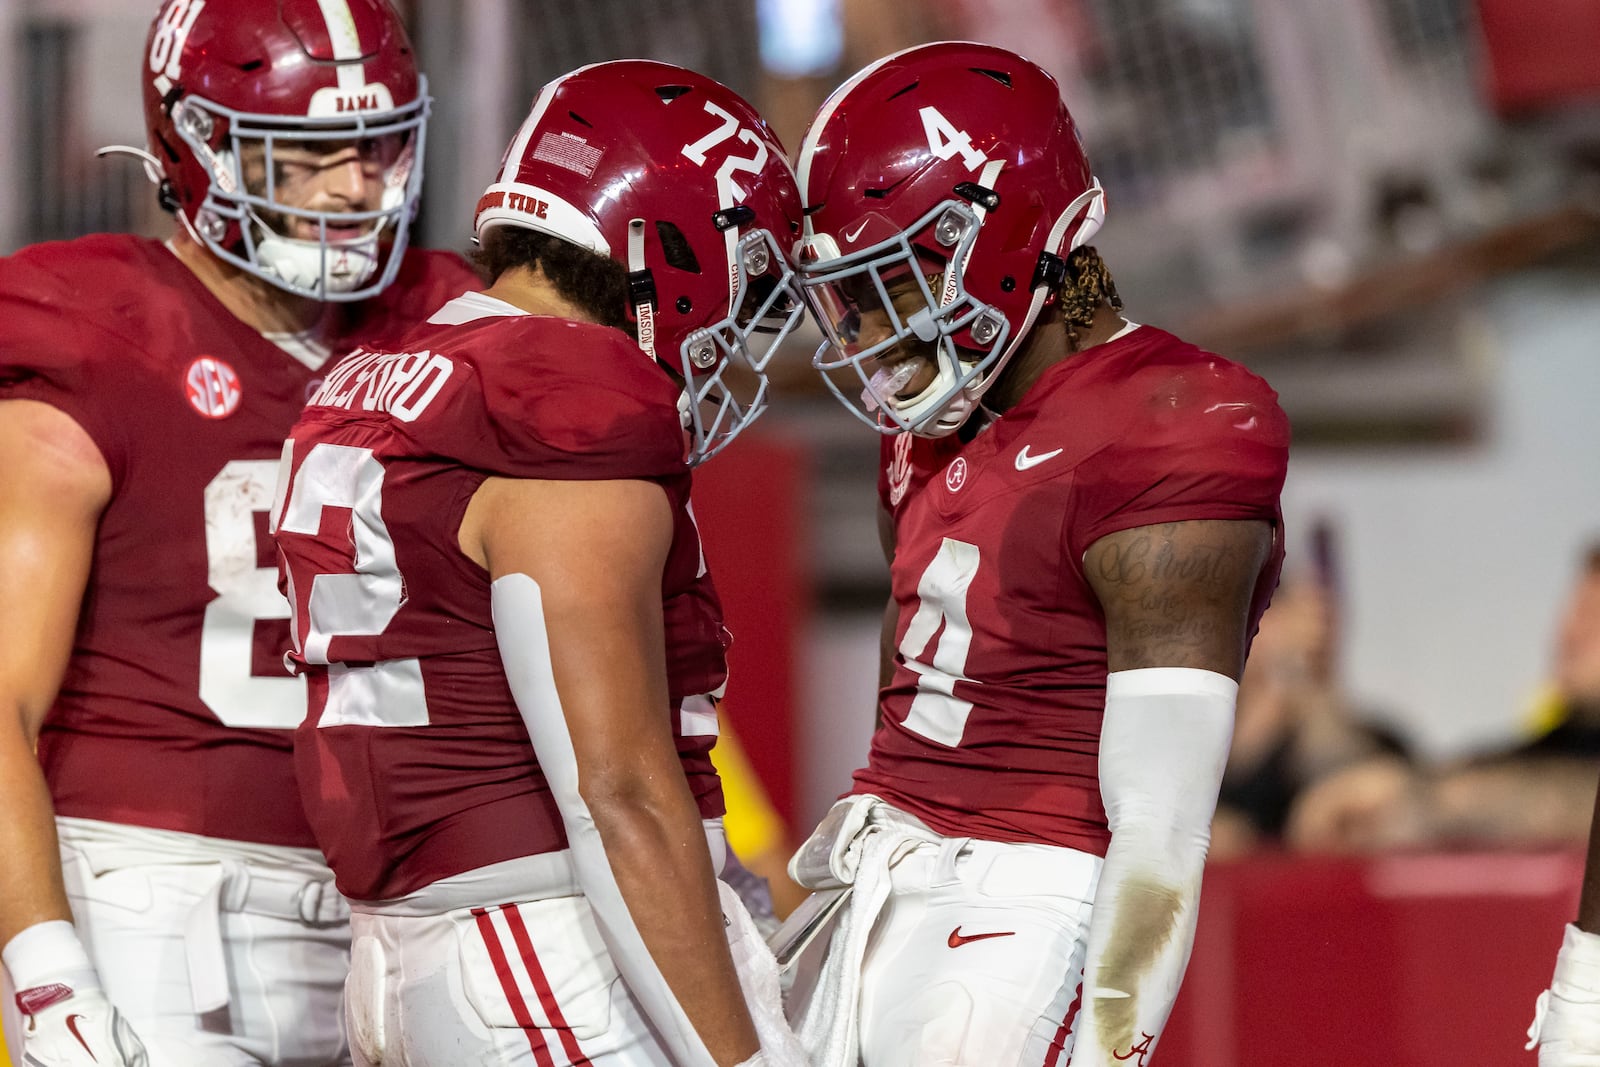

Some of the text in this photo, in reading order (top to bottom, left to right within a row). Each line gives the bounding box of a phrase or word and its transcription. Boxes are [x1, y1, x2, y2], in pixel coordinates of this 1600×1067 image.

[149, 0, 207, 81] 81
[335, 93, 379, 112] BAMA
[561, 131, 587, 144] WARNING
[681, 100, 768, 204] 72
[919, 106, 989, 173] 4
[508, 192, 549, 219] TIDE
[187, 358, 239, 416] SEC
[900, 537, 983, 748] 4
[1113, 1030, 1155, 1067] A
